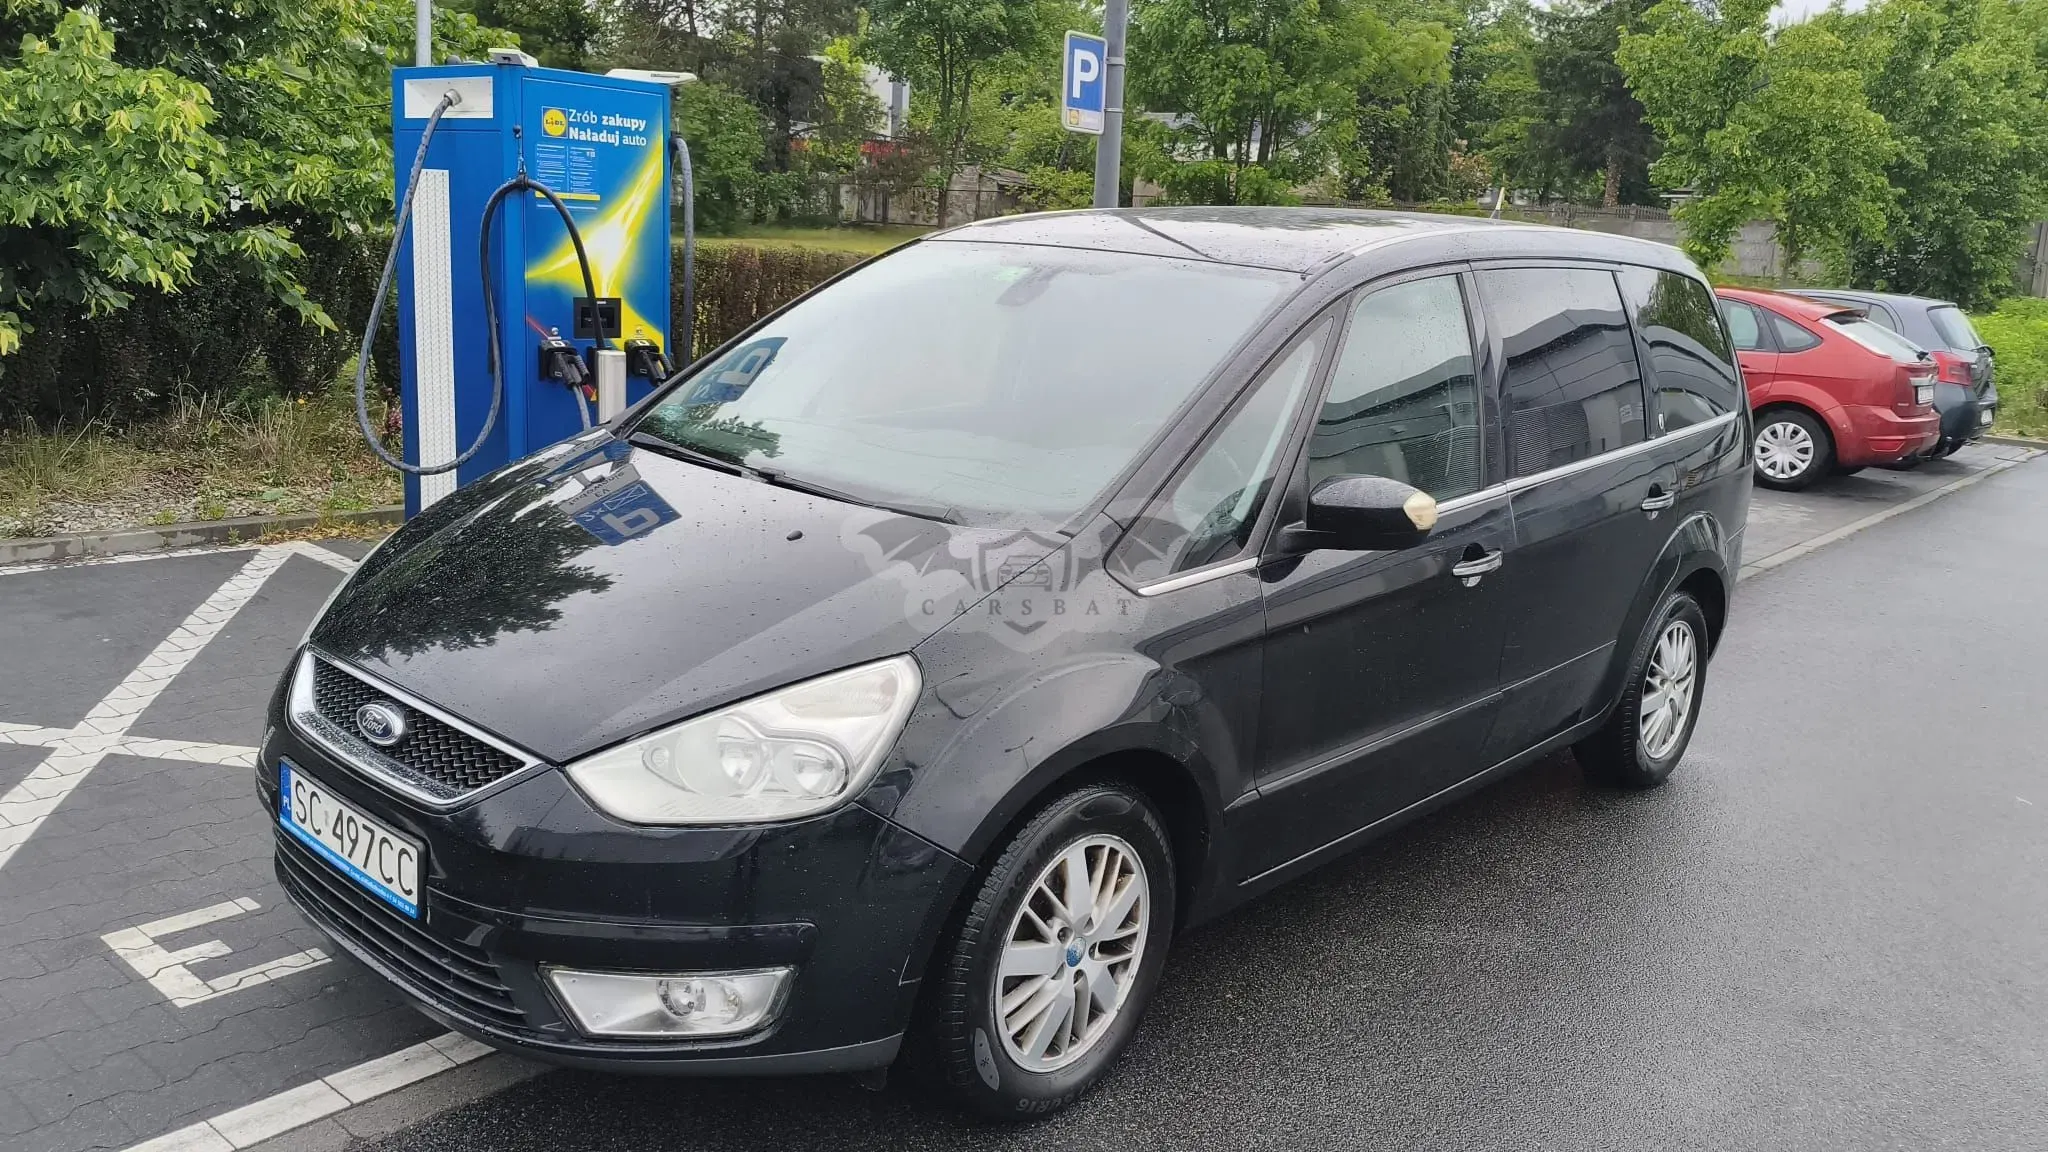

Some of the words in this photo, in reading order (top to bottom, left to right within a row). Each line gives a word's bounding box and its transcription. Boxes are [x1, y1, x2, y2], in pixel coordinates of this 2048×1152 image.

[1072, 48, 1100, 99] P
[568, 108, 598, 124] Zrób
[601, 113, 647, 132] zakupy
[568, 127, 620, 147] Naładuj
[622, 134, 647, 146] auto
[361, 710, 387, 735] Ford
[295, 779, 322, 836] SC
[332, 808, 413, 896] 497CC
